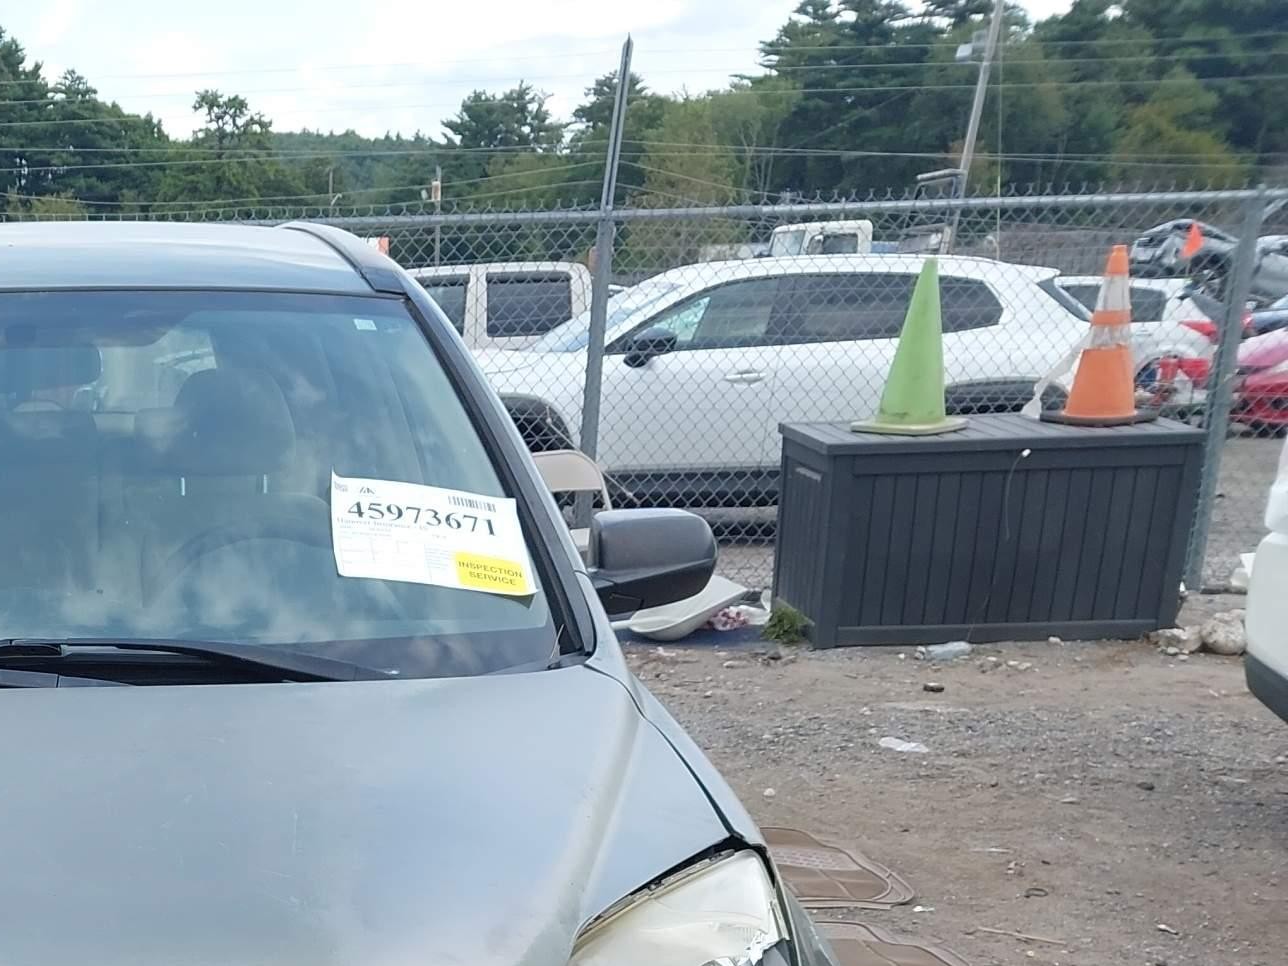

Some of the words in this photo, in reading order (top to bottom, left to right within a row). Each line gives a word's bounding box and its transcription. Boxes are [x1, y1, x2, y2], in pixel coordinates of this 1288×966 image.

[347, 501, 497, 536] 45973671
[458, 560, 523, 578] INSPECTION
[469, 571, 516, 586] SERVICE
